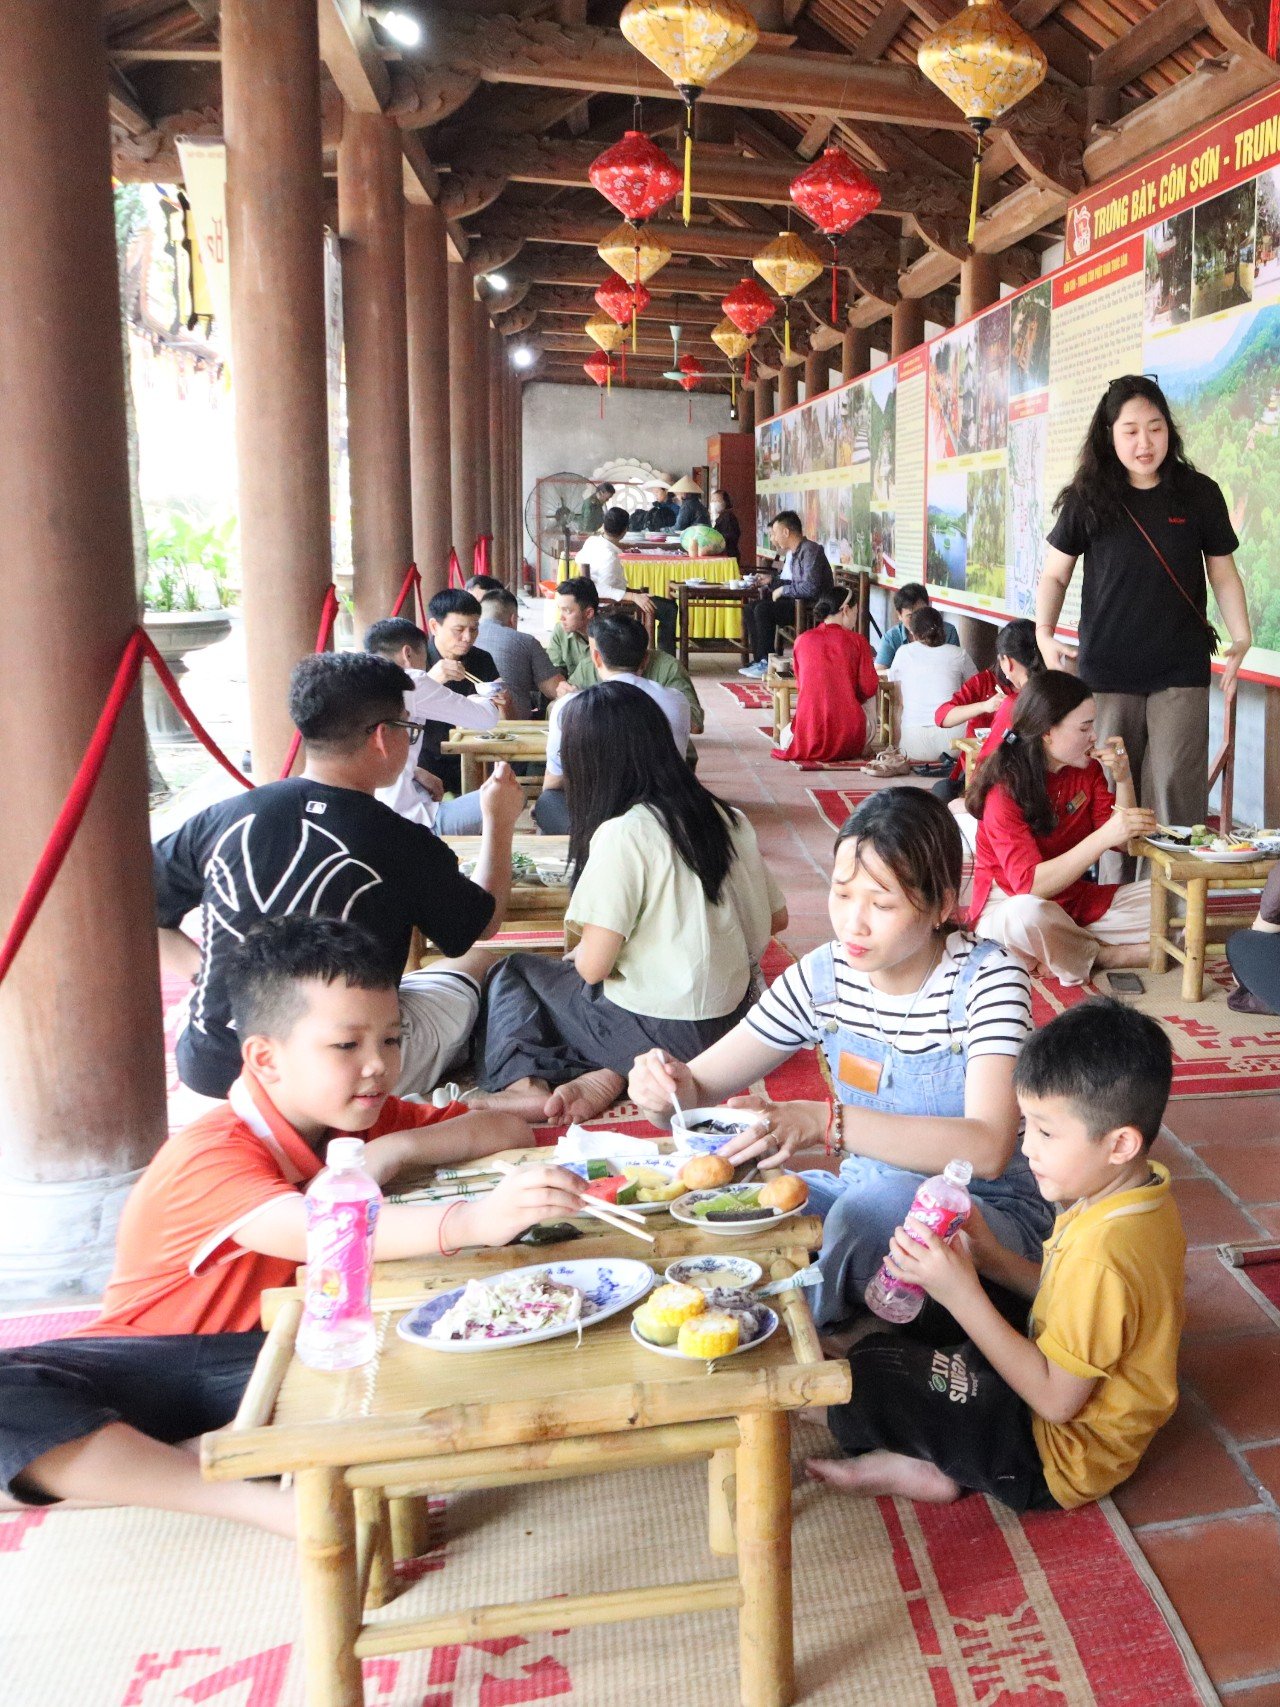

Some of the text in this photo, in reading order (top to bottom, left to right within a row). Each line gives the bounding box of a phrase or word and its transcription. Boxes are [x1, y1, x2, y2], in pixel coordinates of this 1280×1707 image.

[1094, 194, 1129, 240] TRƯNG
[1159, 162, 1187, 209] CÔN
[1189, 144, 1221, 194] SƠN
